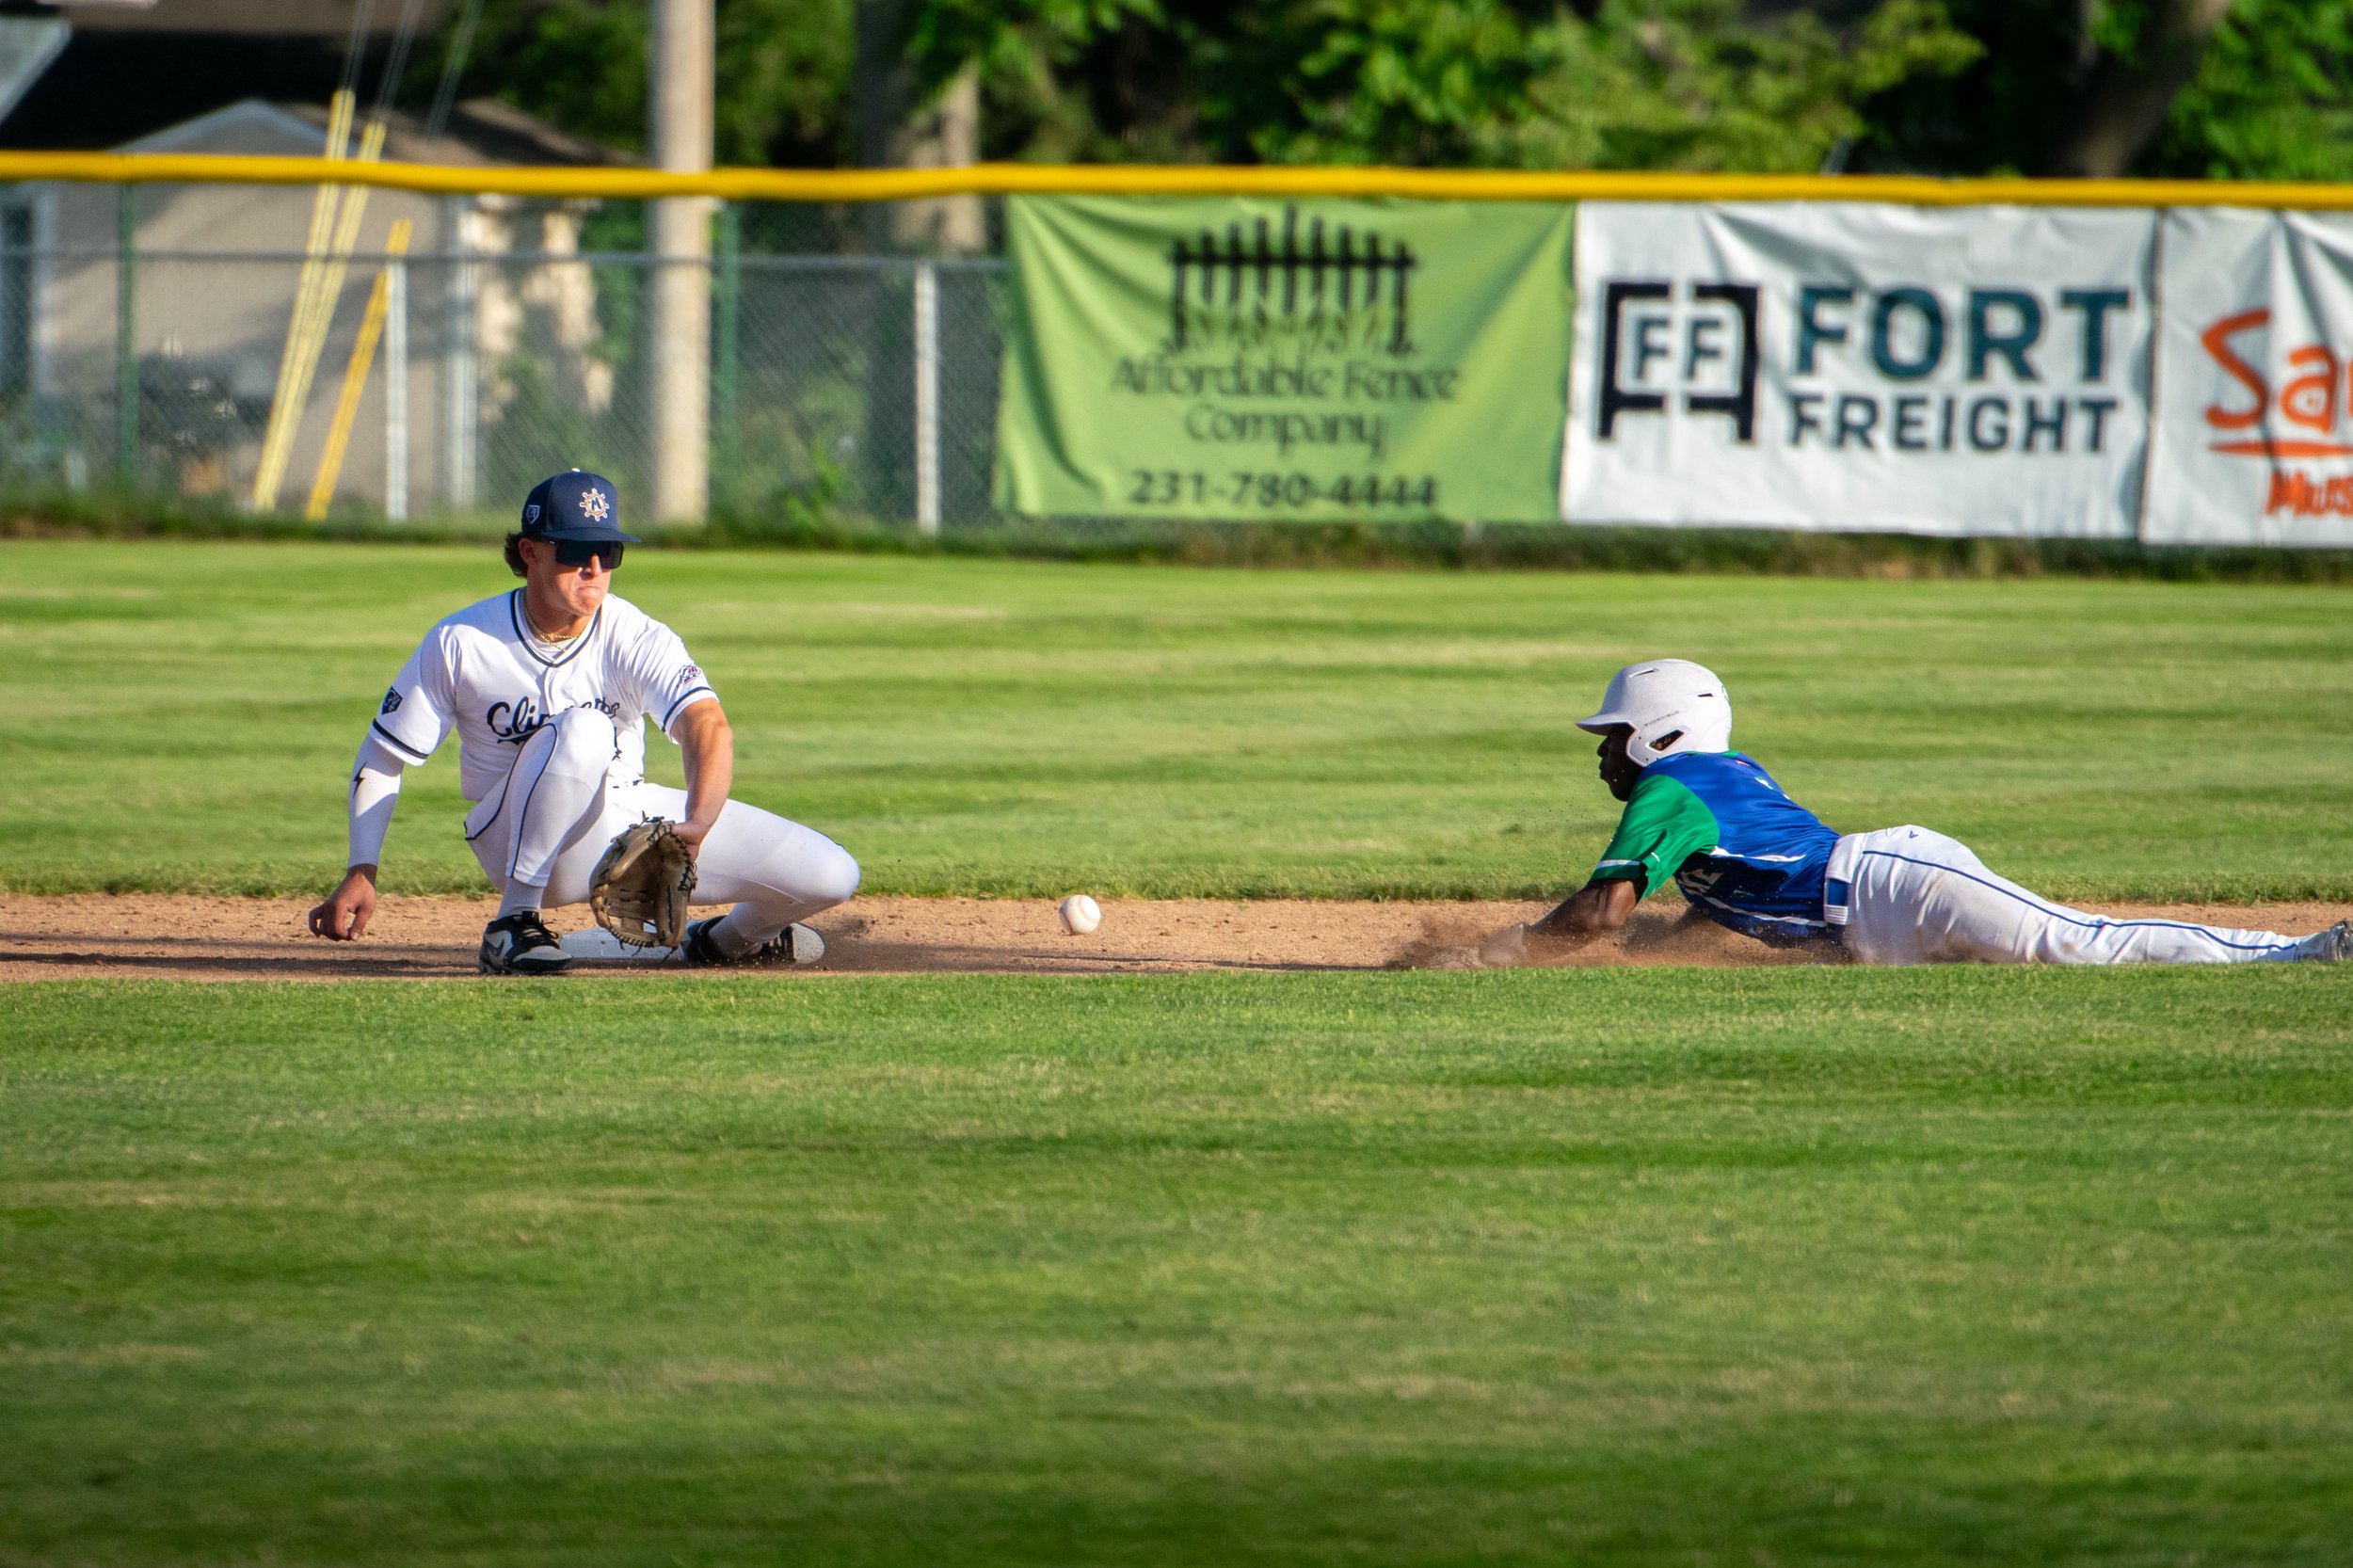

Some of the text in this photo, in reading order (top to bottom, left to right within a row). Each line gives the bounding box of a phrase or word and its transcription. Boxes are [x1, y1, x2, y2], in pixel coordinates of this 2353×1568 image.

[1796, 286, 2131, 380] FORT
[1111, 353, 1459, 401] Affordable Fence
[2200, 306, 2353, 437] Sa
[1184, 402, 1385, 459] Company
[1790, 392, 2120, 452] FREIGHT
[1128, 470, 1437, 508] 231-780-4444
